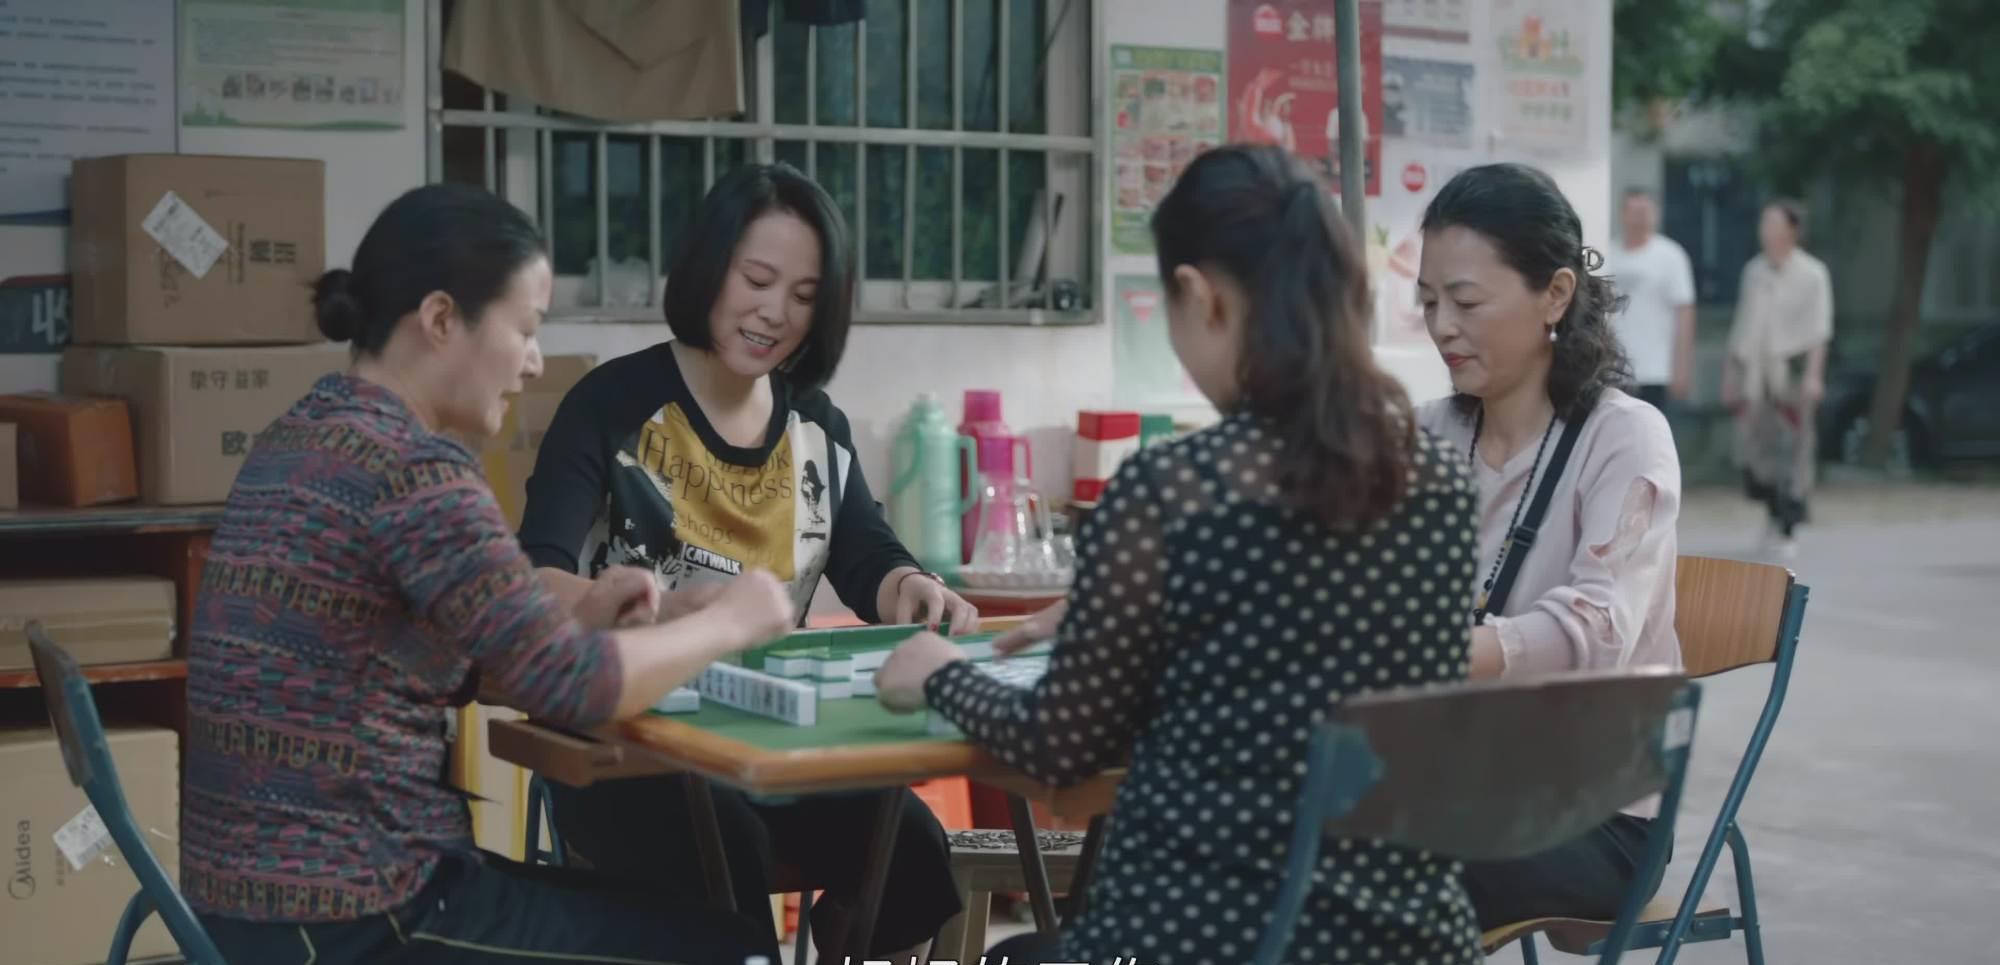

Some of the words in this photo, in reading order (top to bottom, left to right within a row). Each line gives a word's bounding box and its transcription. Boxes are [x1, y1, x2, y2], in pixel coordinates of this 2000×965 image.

[642, 428, 793, 506] Happiness
[685, 546, 741, 576] CATWALK
[13, 818, 34, 891] Midea
